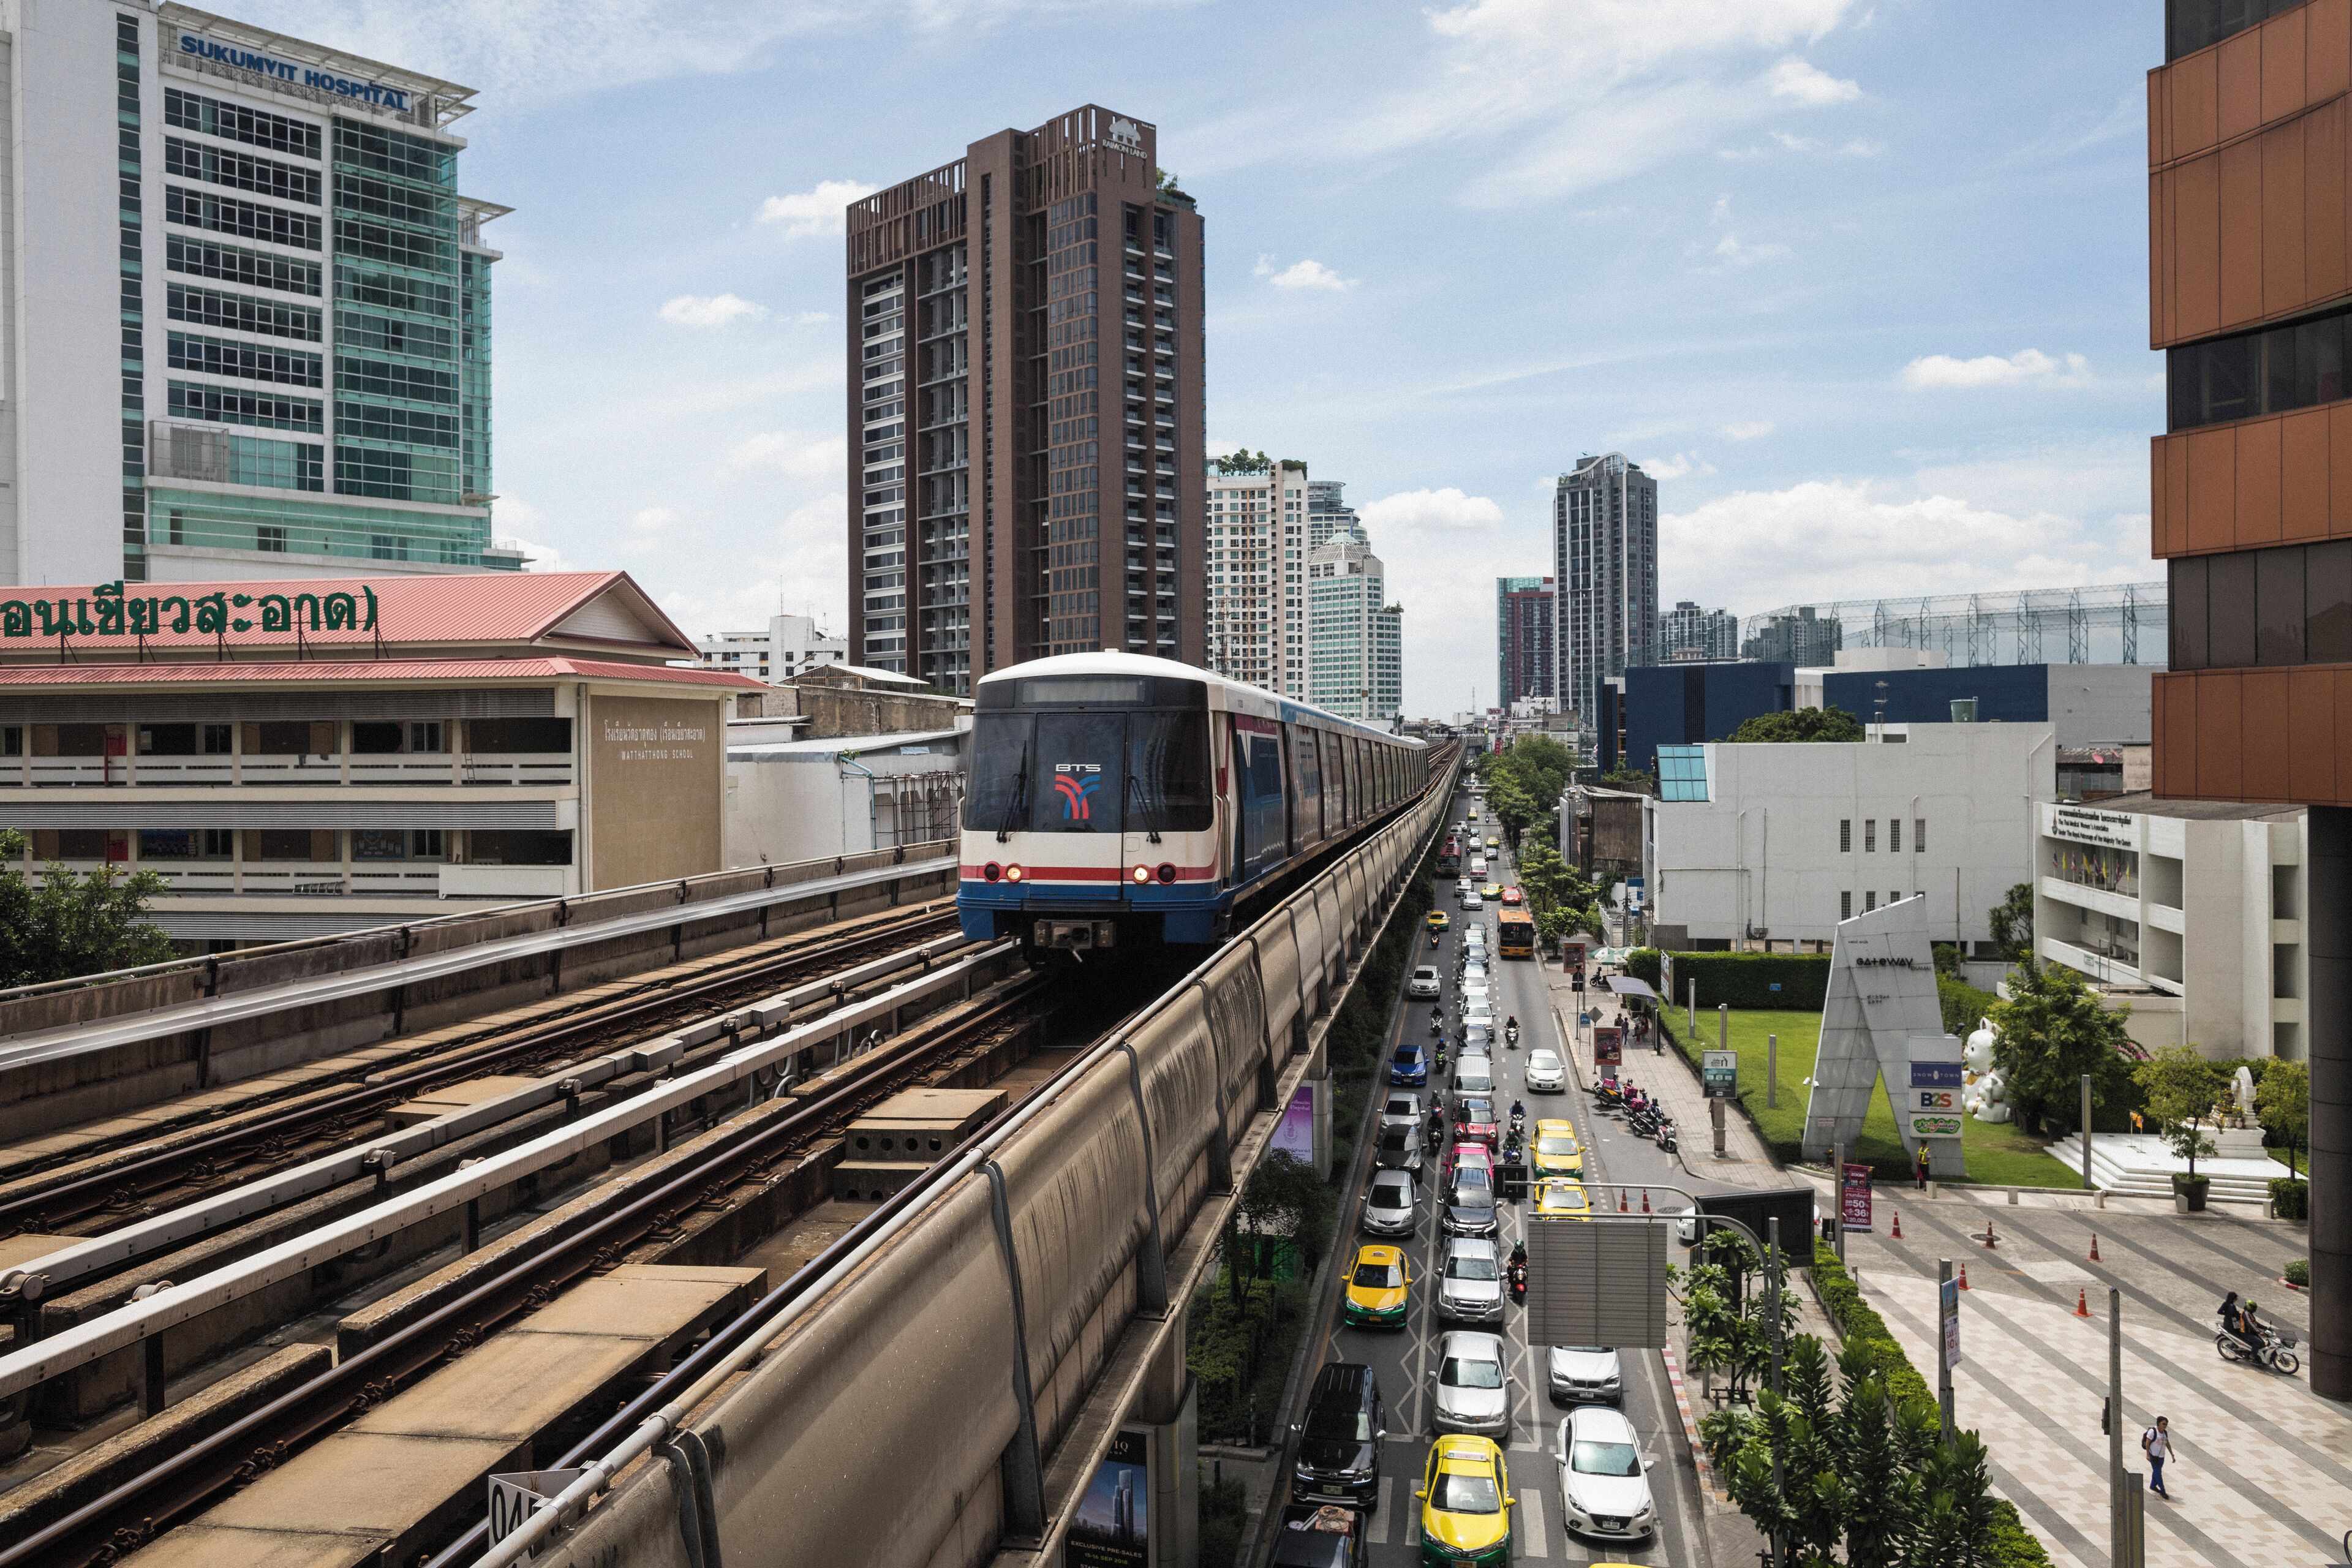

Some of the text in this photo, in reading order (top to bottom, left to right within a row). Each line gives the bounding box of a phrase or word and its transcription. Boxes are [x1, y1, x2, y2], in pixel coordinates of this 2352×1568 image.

[181, 35, 409, 111] SUKUMVIT HOSPITAL
[1130, 148, 1147, 159] LAND
[621, 748, 693, 760] WATTHATTHONG SCHOOL
[1921, 1092, 1952, 1107] B2S
[1071, 1540, 1142, 1558] EXCLUSIVE PRE-SALES
